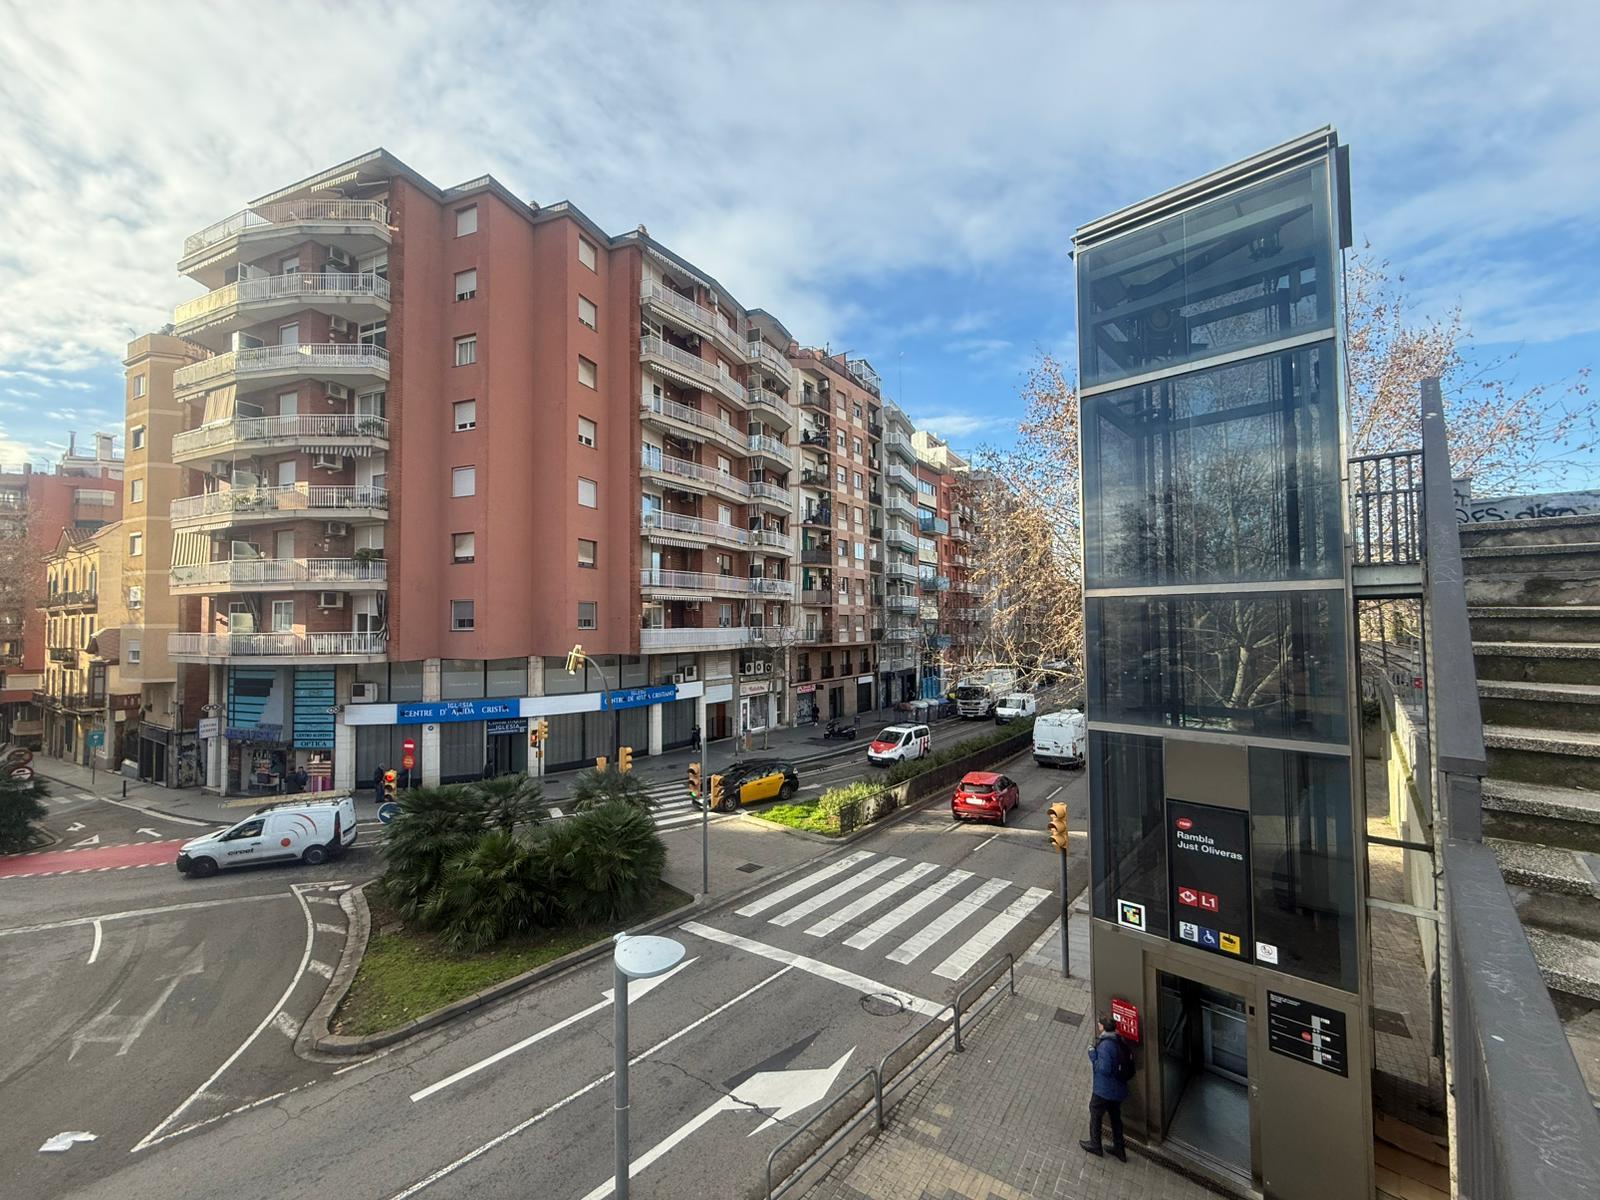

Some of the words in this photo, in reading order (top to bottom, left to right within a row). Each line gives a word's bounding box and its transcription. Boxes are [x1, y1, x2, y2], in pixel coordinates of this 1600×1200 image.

[1176, 830, 1215, 846] Rambla
[1177, 840, 1199, 852] Just
[1200, 844, 1244, 861] Oliveras
[1201, 895, 1216, 908] L1
